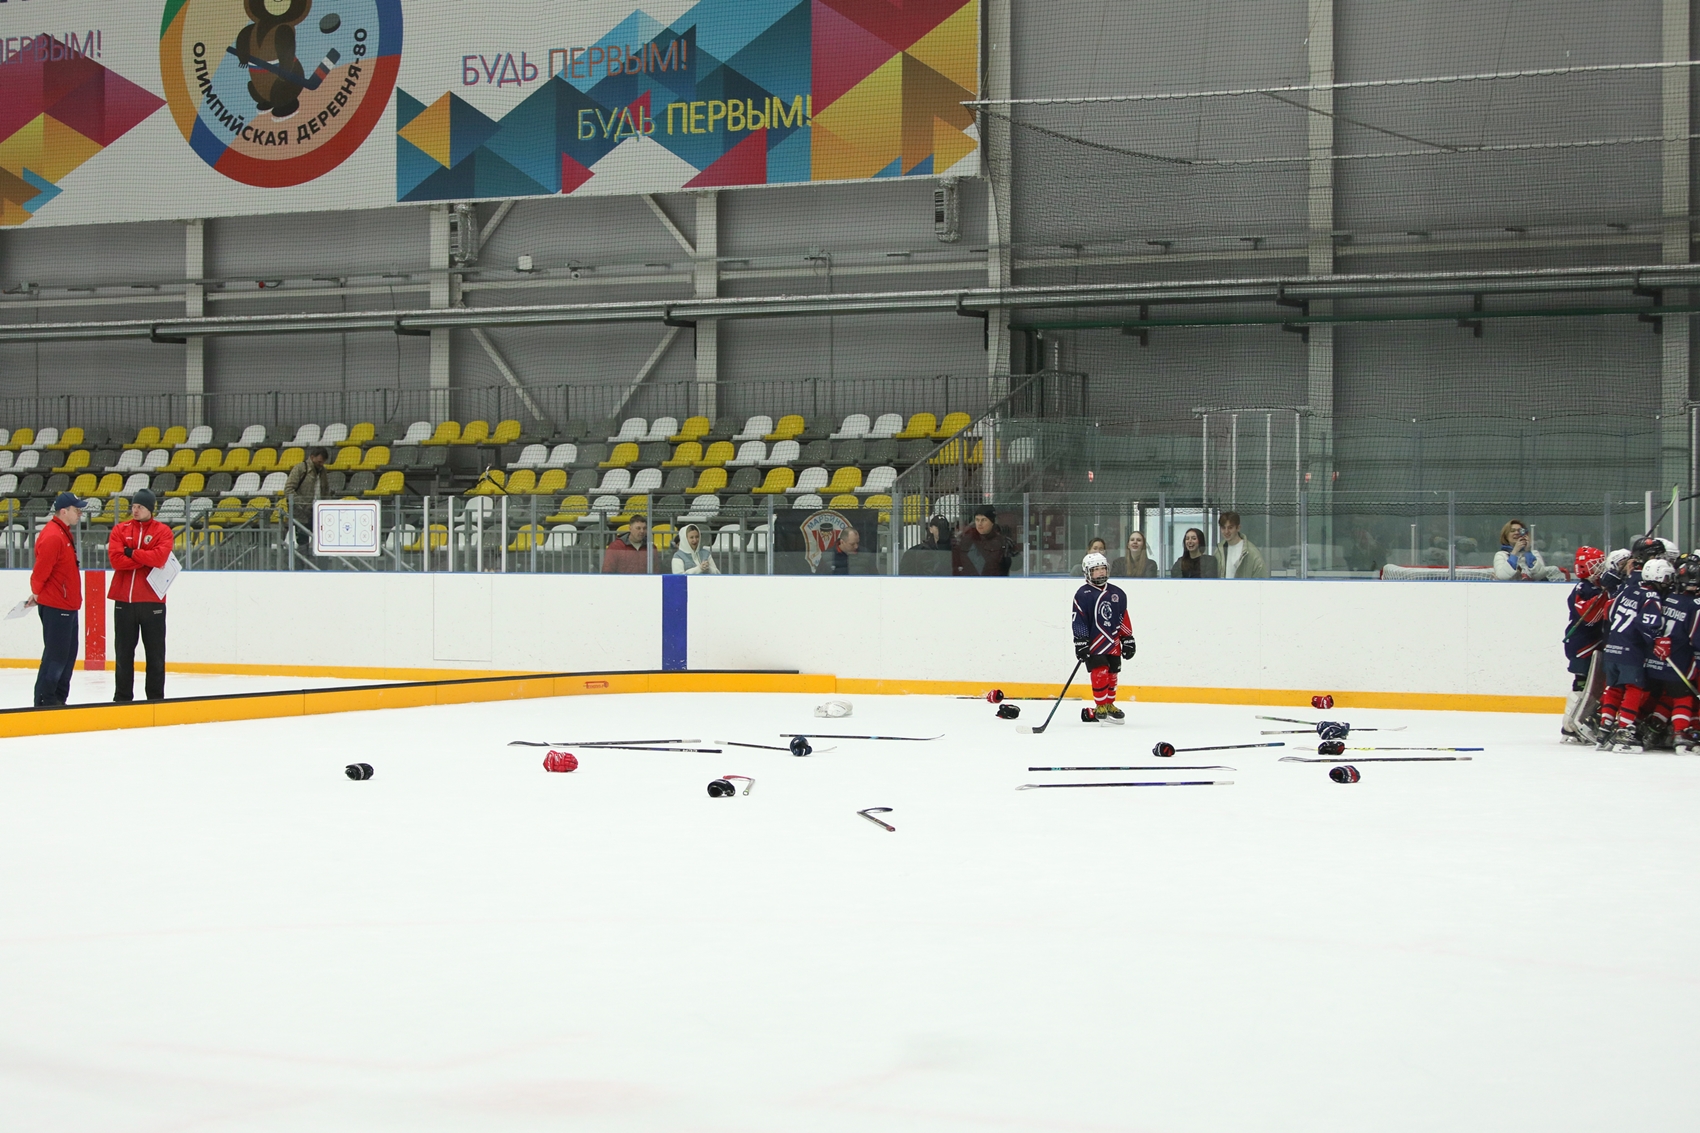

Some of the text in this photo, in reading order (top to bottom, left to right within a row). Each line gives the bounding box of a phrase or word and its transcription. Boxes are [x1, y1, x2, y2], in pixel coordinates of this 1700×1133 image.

[0, 29, 102, 65] ЕРВЫМ!
[462, 40, 687, 88] БУДЬ ПЕРВЫМ!
[193, 28, 367, 146] ОЛИМПИЙСКАЯ ДЕРЕВНЯ-80
[577, 94, 813, 143] БУДЬ ПЕРВЫМ!
[1642, 613, 1657, 624] 57
